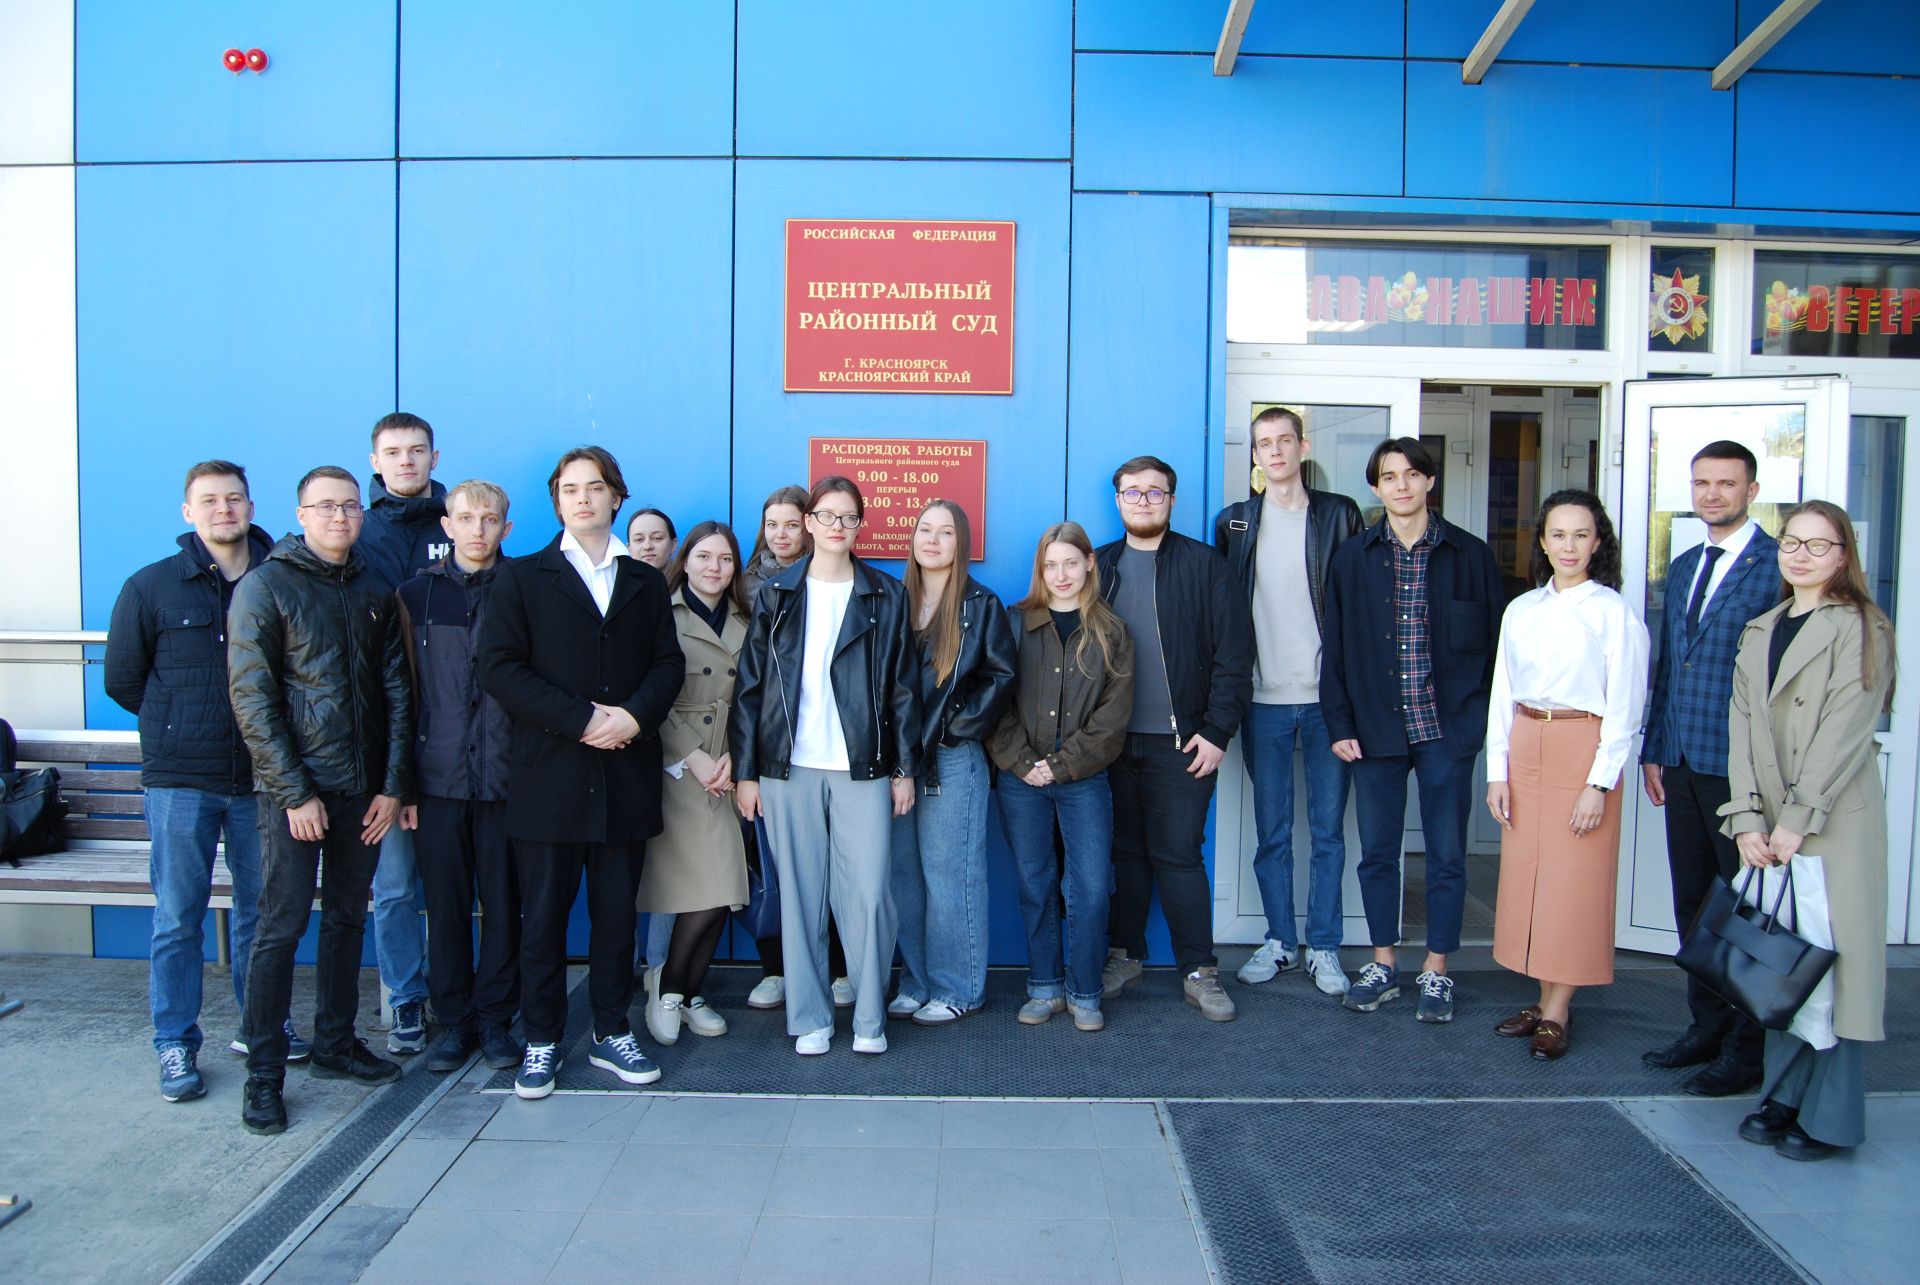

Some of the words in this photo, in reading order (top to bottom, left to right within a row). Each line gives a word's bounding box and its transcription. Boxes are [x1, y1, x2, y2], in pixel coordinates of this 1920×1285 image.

[803, 227, 895, 240] РОССИЙСКАЯ
[912, 230, 997, 242] ФЕДЕРАЦИЯ
[807, 280, 992, 301] ЦЕНТРАЛЬНЫЙ
[1425, 276, 1597, 326] НАШИМ
[1807, 285, 1920, 335] ВЕТЕР
[799, 309, 937, 331] РАЙОННЫЙ
[951, 314, 998, 335] СУД
[844, 358, 855, 369] Г.
[859, 358, 948, 370] КРАСНОЯРСК
[818, 370, 930, 383] КРАСНОЯРСКИЙ
[934, 371, 971, 384] КРАЙ
[822, 443, 911, 456] РАСПОРЯДОК
[917, 445, 973, 457] РАБОТЫ
[835, 456, 893, 466] Центрального
[896, 458, 939, 467] районного
[857, 470, 888, 482] 9.00
[903, 472, 939, 484] 18.00
[876, 486, 918, 494] ПЕРЕРЫВ
[862, 496, 891, 508] 3.00
[906, 497, 942, 509] 13.4
